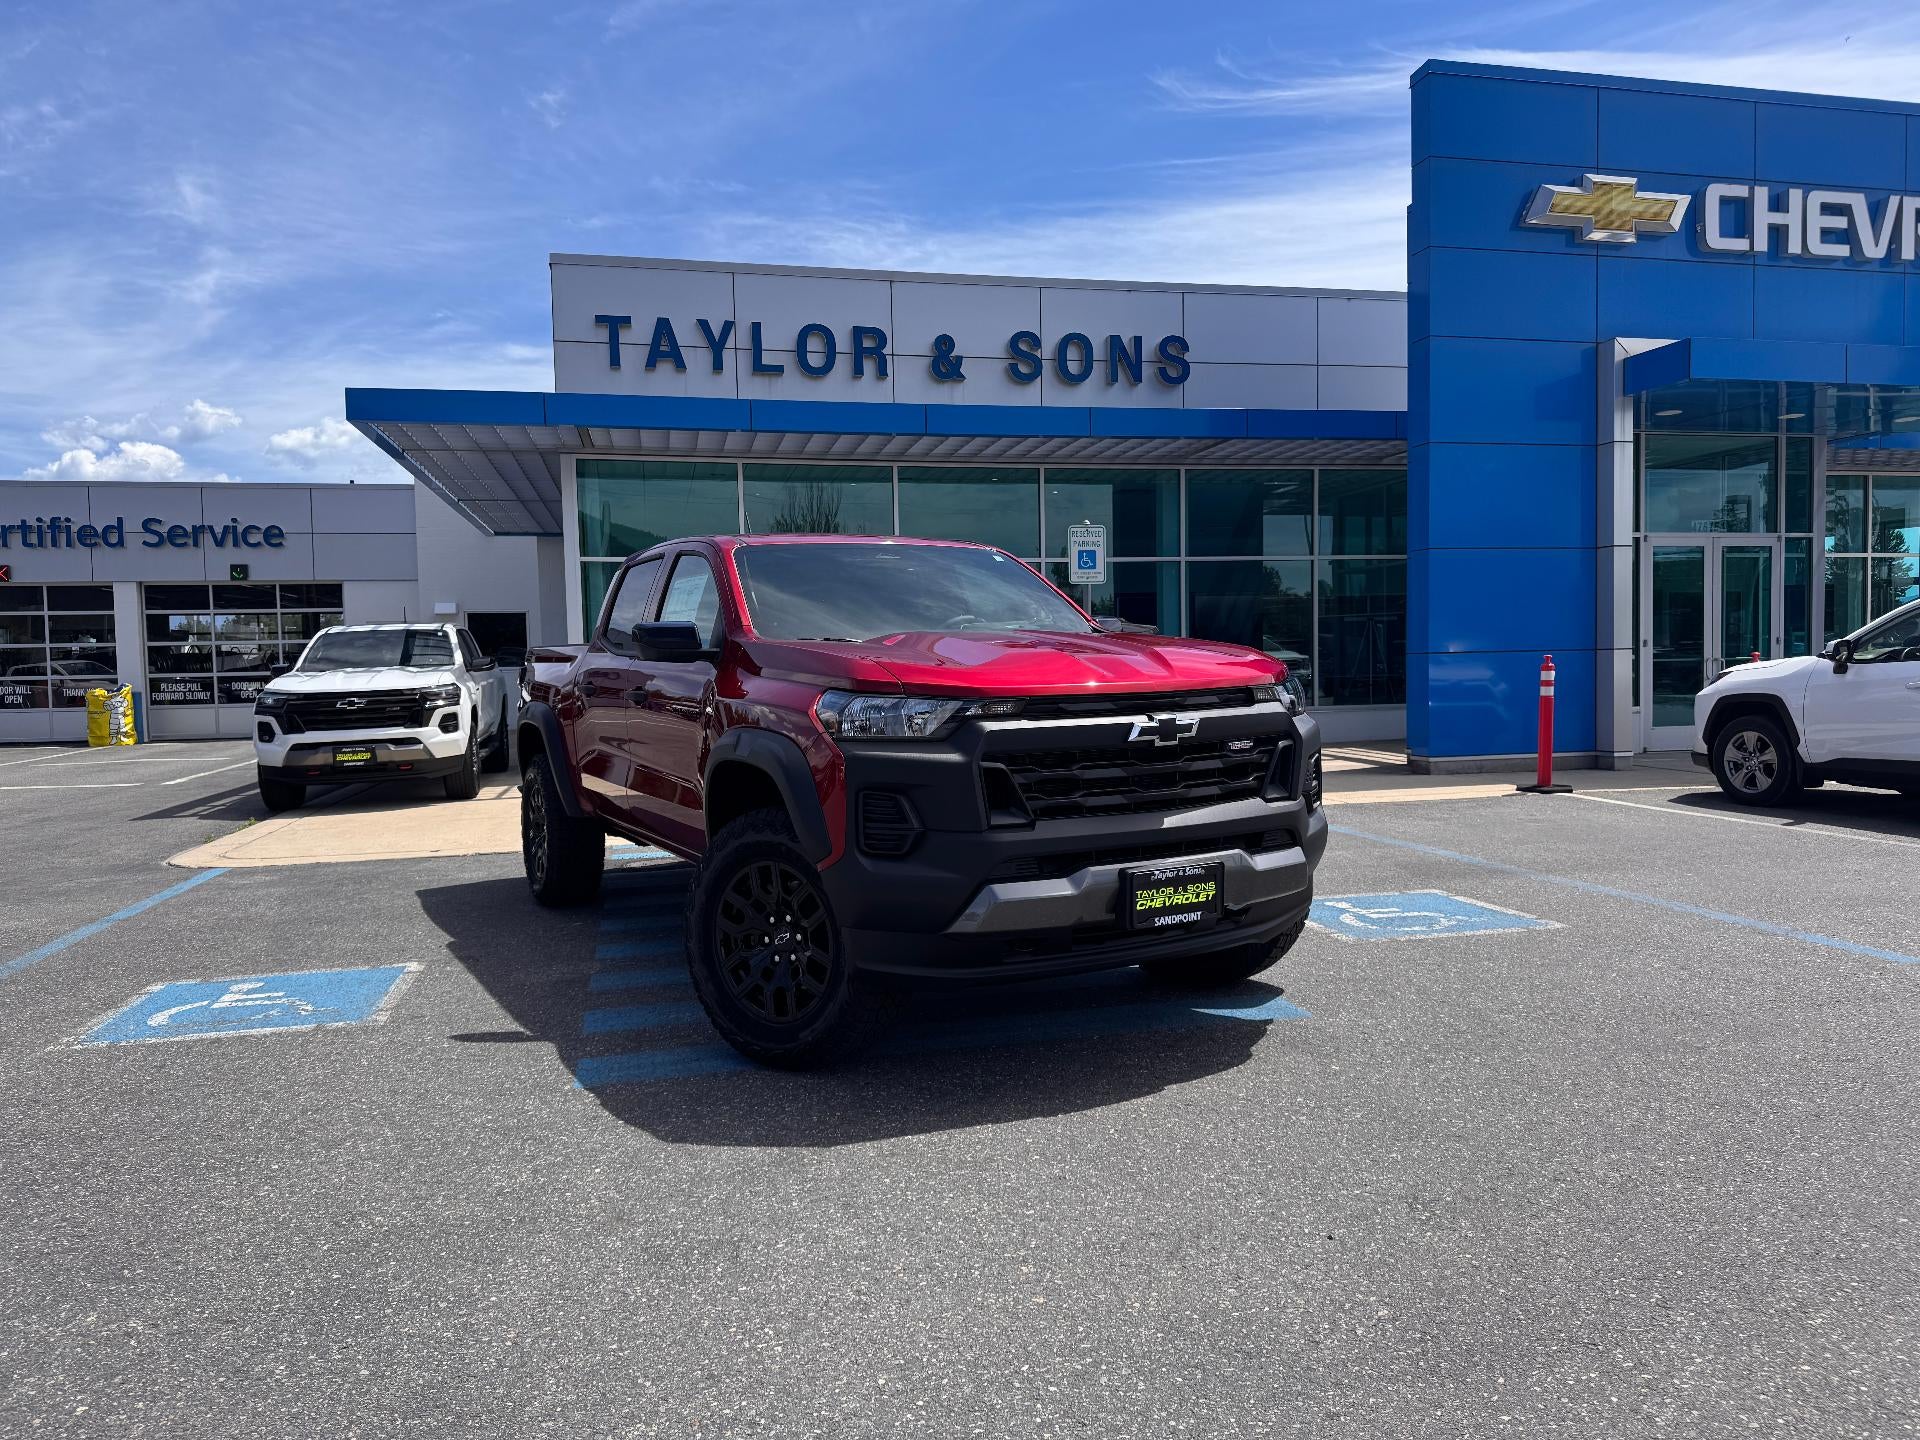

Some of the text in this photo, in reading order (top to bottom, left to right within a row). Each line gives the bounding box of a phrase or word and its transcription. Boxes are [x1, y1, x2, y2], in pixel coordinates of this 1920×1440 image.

[594, 314, 1191, 386] TAYLOR & SONS
[0, 516, 285, 549] rtified Service
[1071, 530, 1103, 538] RESERVED
[1073, 540, 1101, 548] PARKING
[14, 685, 32, 695] WILL
[160, 682, 202, 692] PLEASE PULL
[231, 681, 249, 691] DOOR
[63, 688, 84, 697] THANK
[152, 691, 211, 701] FORWARD SLOWLY
[240, 690, 258, 699] OPEN
[4, 694, 23, 704] OPEN
[1153, 869, 1178, 880] Taylor
[1184, 866, 1202, 876] Sons
[1136, 886, 1174, 899] TAYLOR
[1187, 881, 1216, 893] SONS
[1136, 891, 1216, 911] CHEVROLET
[1154, 911, 1202, 927] SANDPOINT
